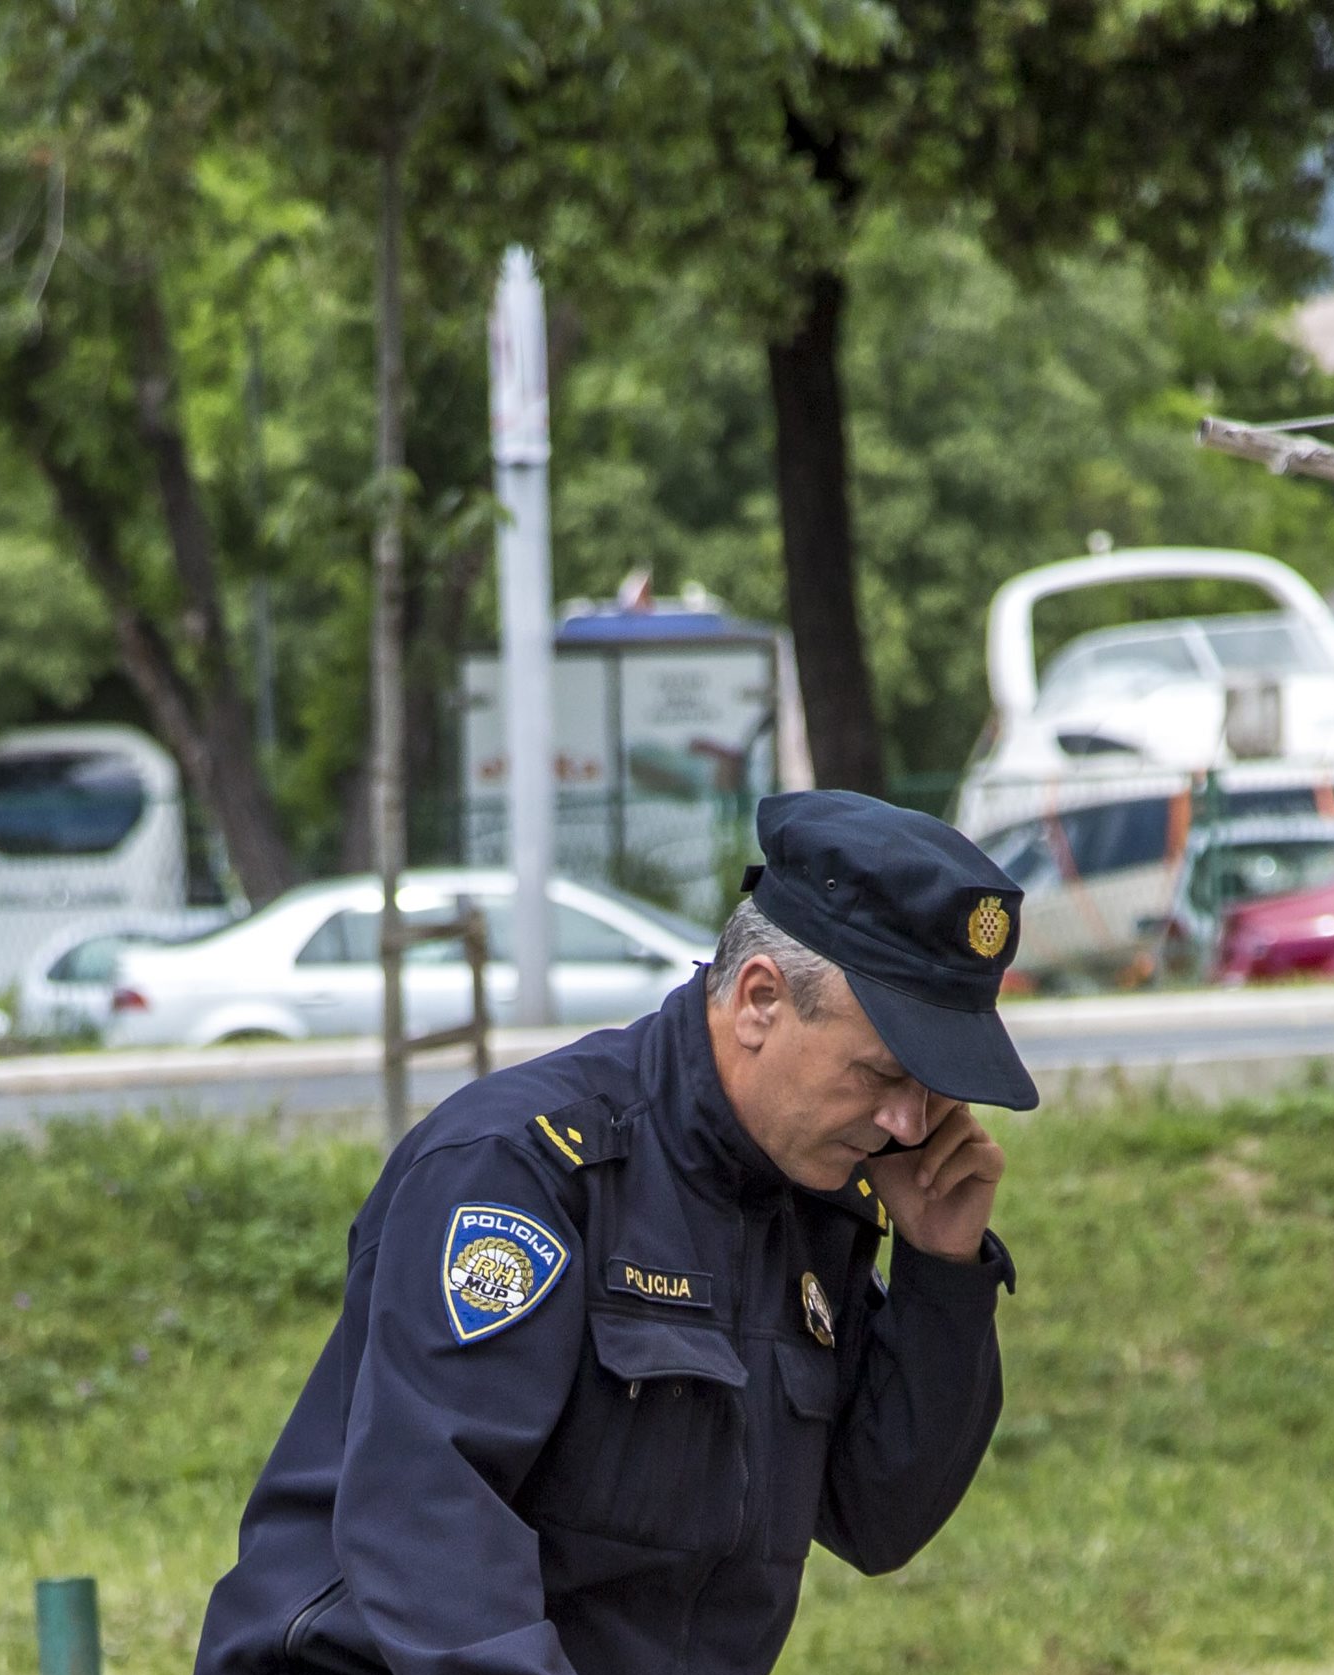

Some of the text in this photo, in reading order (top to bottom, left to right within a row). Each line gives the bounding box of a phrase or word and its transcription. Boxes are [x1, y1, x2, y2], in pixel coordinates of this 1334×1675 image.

[462, 1214, 556, 1266] POLICIJA
[464, 1275, 508, 1299] MUP
[472, 1256, 516, 1288] RH
[625, 1265, 692, 1298] POLICIJA
